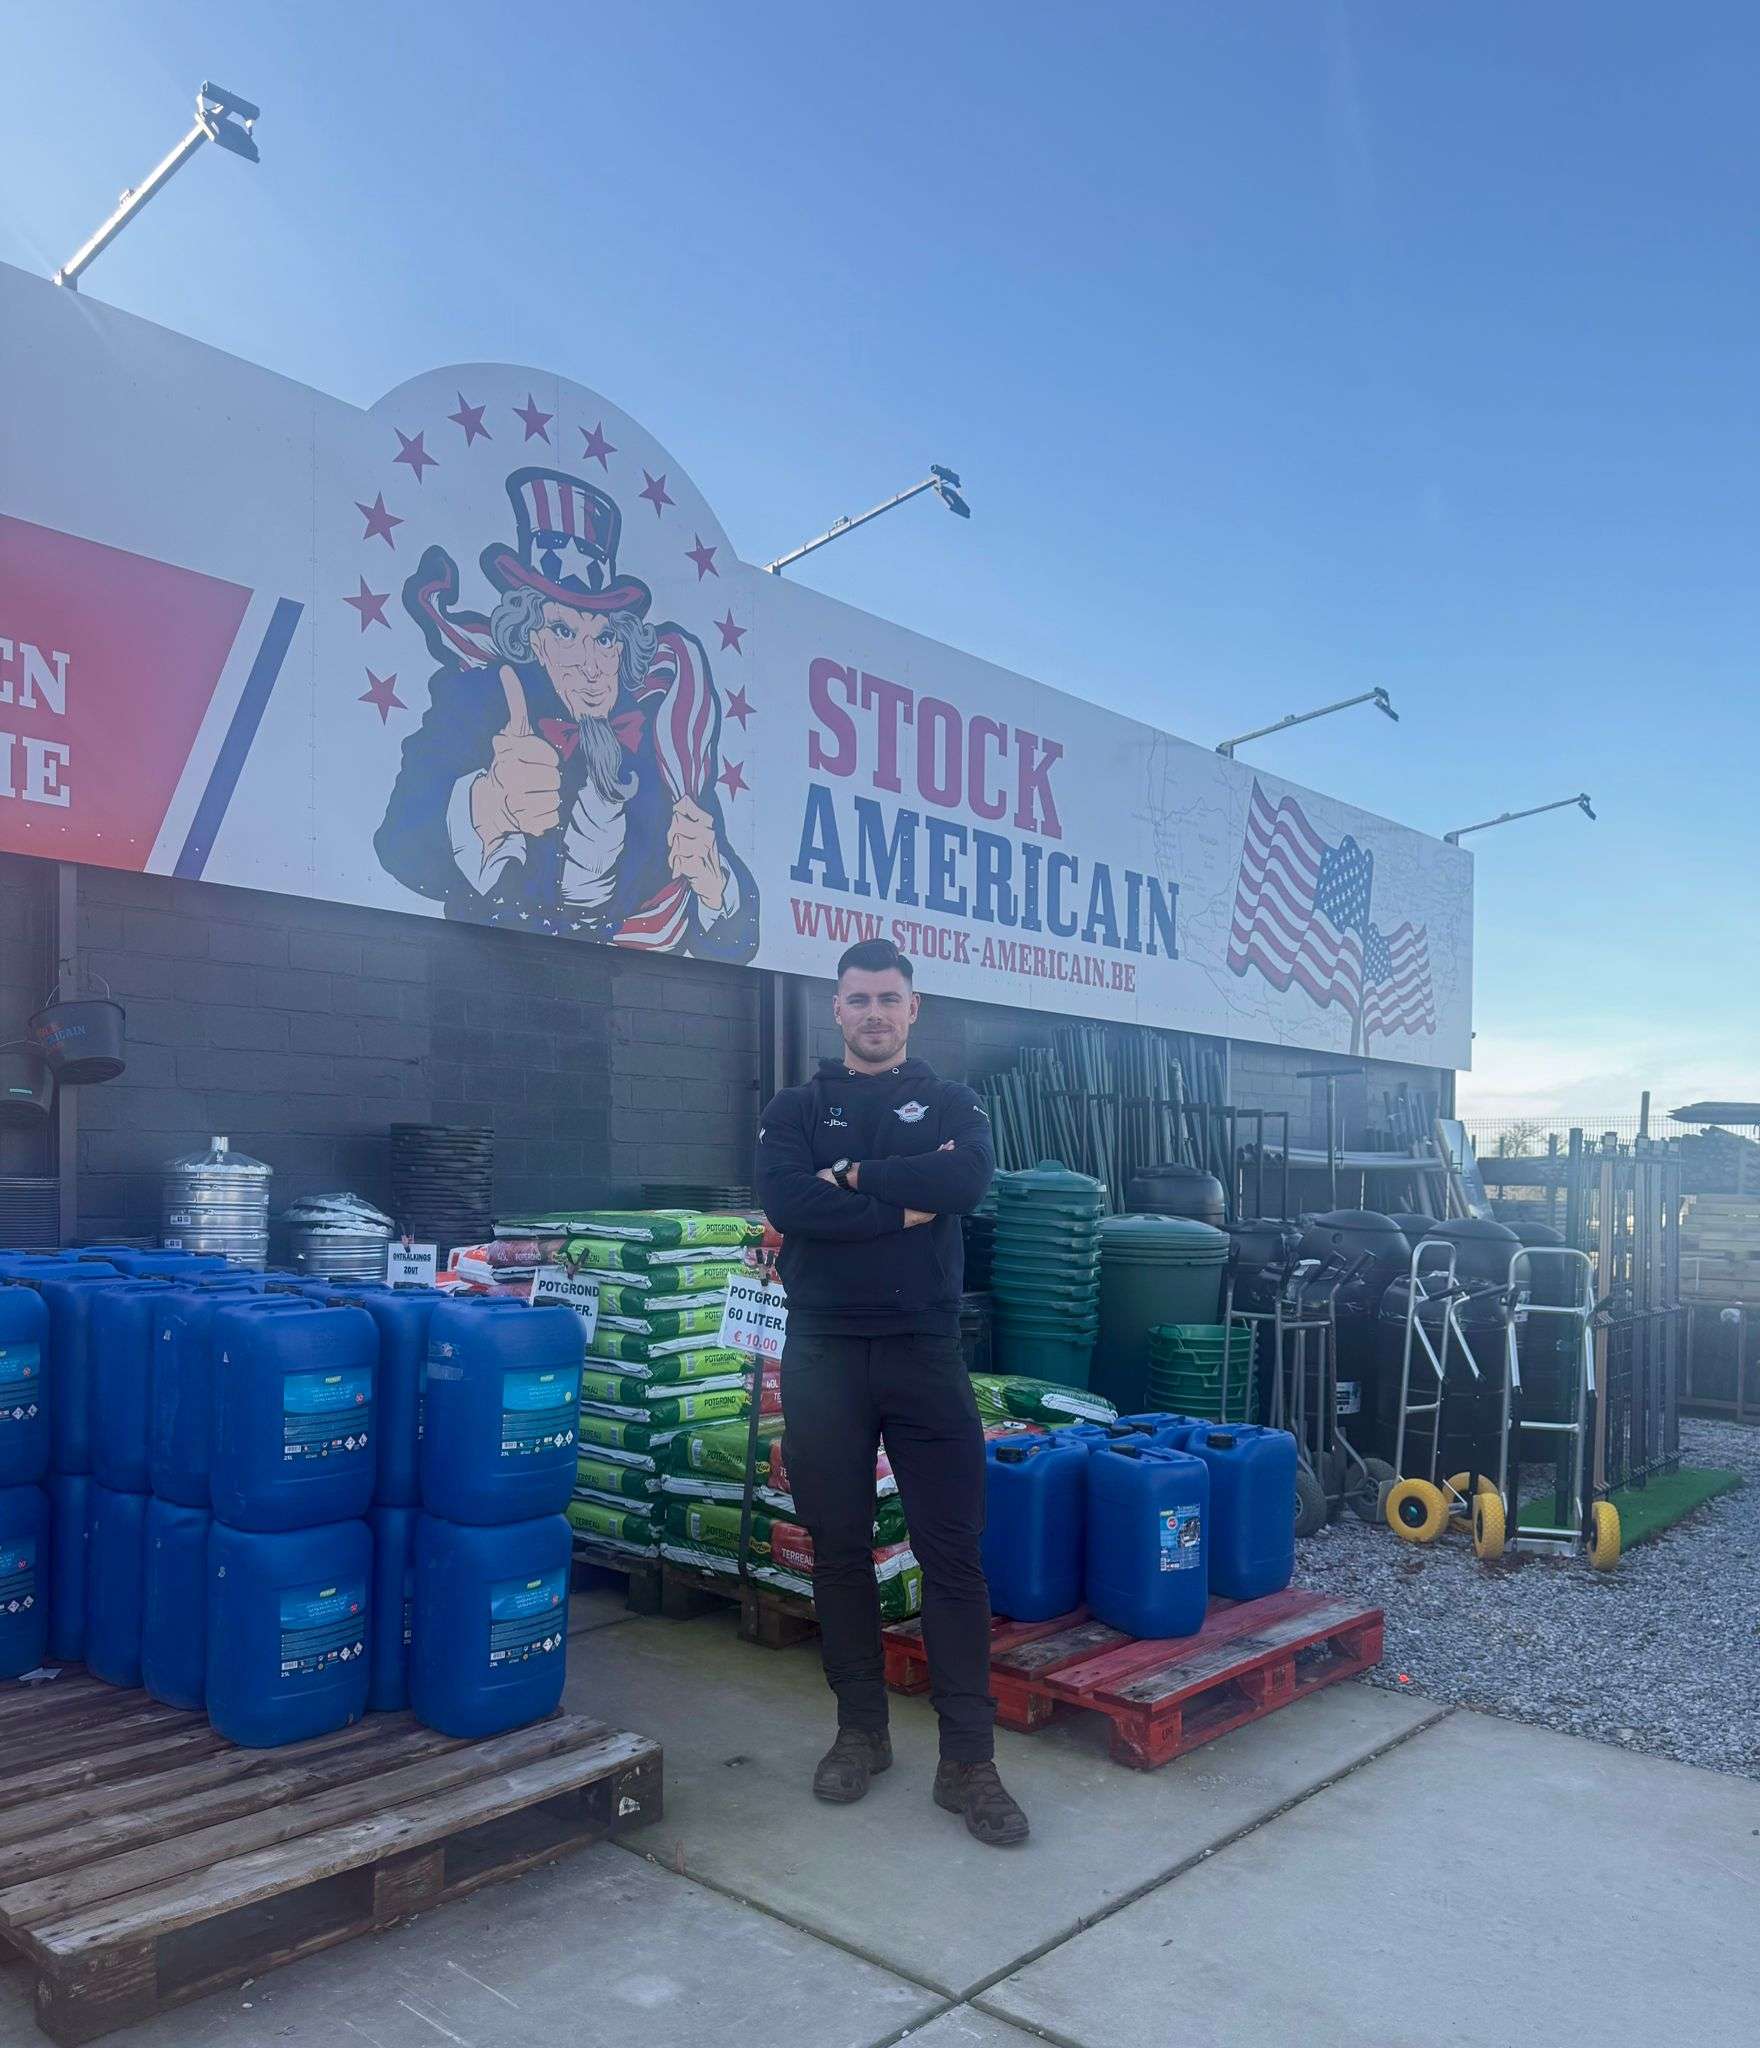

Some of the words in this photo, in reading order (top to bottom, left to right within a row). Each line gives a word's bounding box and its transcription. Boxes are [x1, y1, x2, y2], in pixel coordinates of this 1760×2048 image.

[808, 657, 1063, 840] STOCK
[790, 782, 1180, 960] AMERICAIN
[790, 898, 1136, 993] WWWSTOCK-AMERICAIN.BE
[404, 1266, 418, 1275] ZOUT
[538, 1280, 600, 1297] POTGROND
[730, 1286, 787, 1308] POTGRO
[728, 1307, 743, 1320] 60
[746, 1311, 785, 1331] LITER.
[734, 1330, 743, 1343] €
[746, 1333, 778, 1352] 10.00
[705, 1353, 737, 1363] POTGROND
[705, 1396, 737, 1407] POTGROND
[782, 1547, 815, 1567] TERREAU
